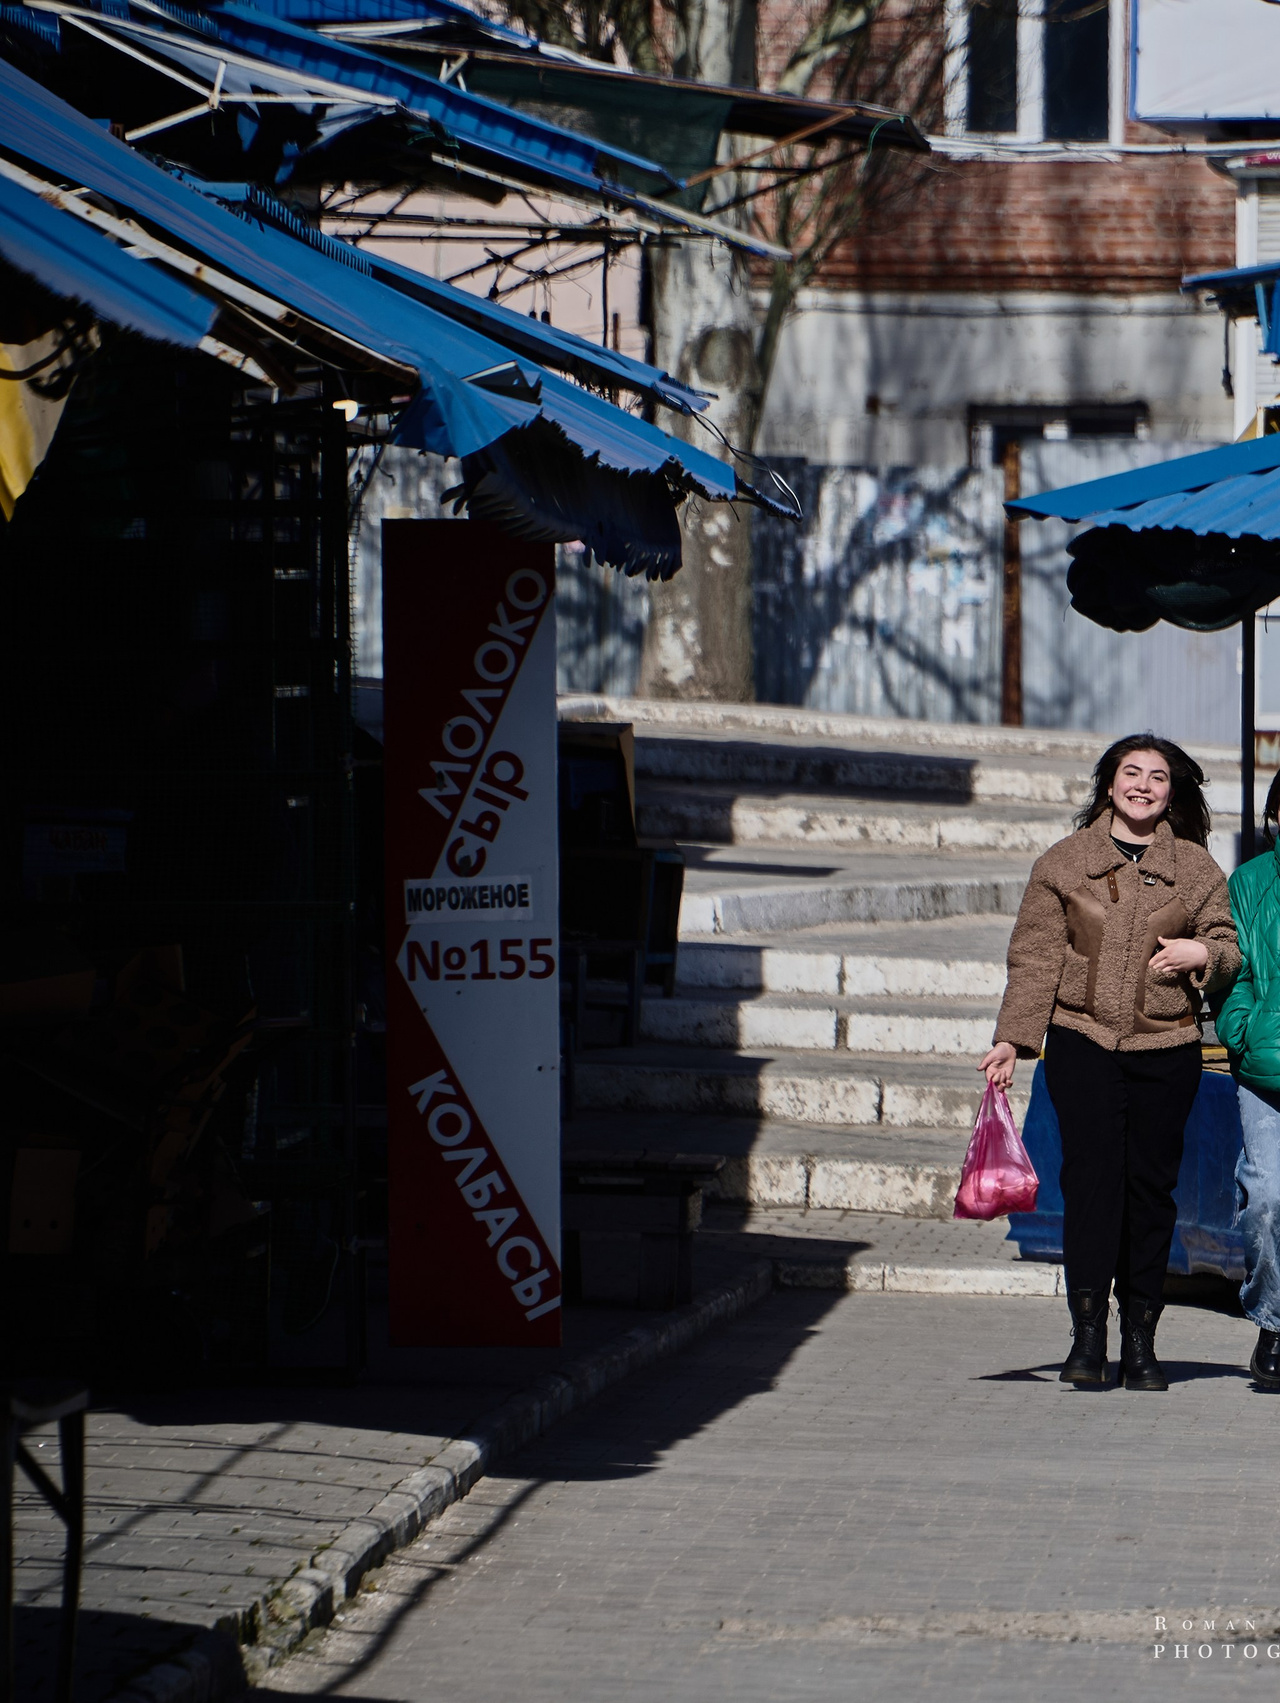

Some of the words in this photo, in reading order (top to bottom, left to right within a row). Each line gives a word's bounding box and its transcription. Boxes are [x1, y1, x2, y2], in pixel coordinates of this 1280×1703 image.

[417, 568, 547, 820] МОЛОКО
[407, 884, 529, 912] МОРОЖЕНОЕ
[407, 938, 555, 981] №155
[407, 1068, 561, 1323] КОЛБАСЫ
